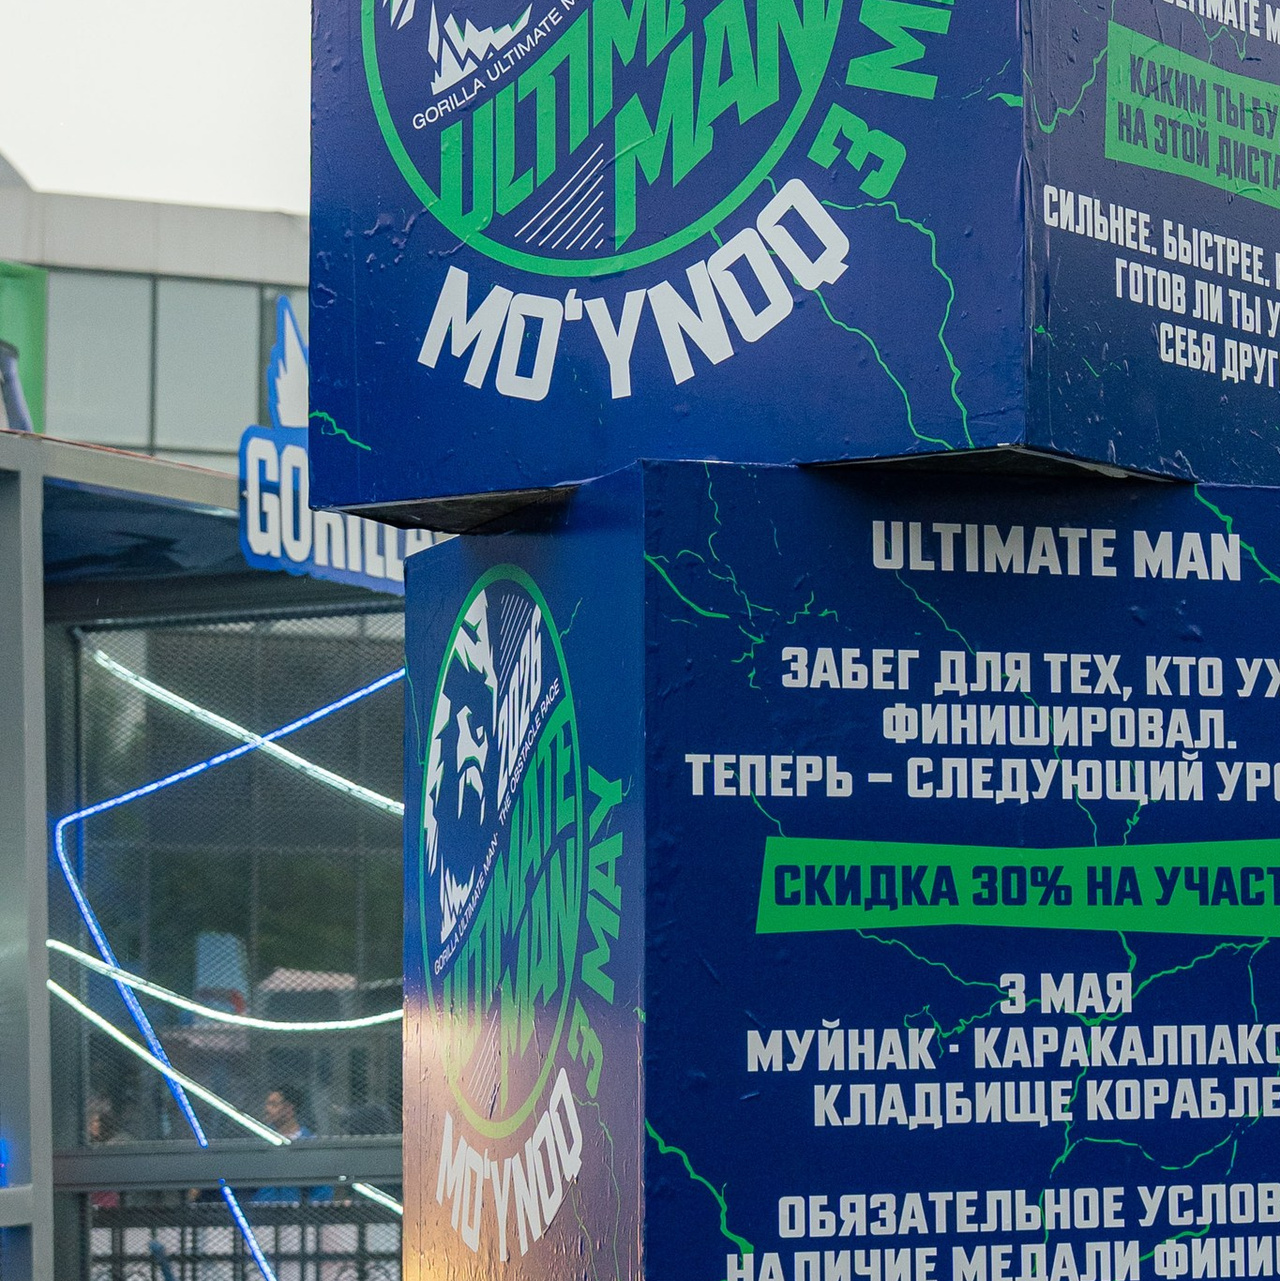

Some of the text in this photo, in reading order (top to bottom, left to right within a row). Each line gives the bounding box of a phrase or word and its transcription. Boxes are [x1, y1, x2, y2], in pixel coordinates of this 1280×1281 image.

[411, 77, 486, 131] GORILLA
[485, 6, 563, 82] ULTIMATE
[1129, 52, 1207, 118] КАКИМ
[1212, 82, 1246, 131] ТЫ
[807, 103, 908, 200] 3
[1117, 101, 1149, 150] НА
[1153, 113, 1210, 169] ЭТОЙ
[1043, 184, 1157, 256] СИЛЬНЕЕ.
[1162, 218, 1271, 288] БЫСТРЕЕ.
[1115, 257, 1186, 315] ГОТОВ
[1192, 279, 1224, 325] ЛИ
[1228, 288, 1262, 335] ТЫ
[1159, 322, 1216, 374] СЕБЯ
[872, 521, 1241, 581] ULTIMATE MAN
[497, 603, 543, 811] 2026
[781, 646, 920, 690] ЗАБЕГ
[934, 650, 1031, 697] ДЛЯ
[1043, 653, 1133, 702] ТЕХ,
[1146, 655, 1223, 697] КТО
[882, 703, 1237, 749] ФИНИШИРОВАЛ.
[685, 753, 853, 797] ТЕПЕРЬ
[907, 751, 1204, 806] СЛЕДУЮЩИЙ
[433, 931, 460, 976] GORILLA
[457, 872, 486, 937] ULTIMATE
[498, 791, 513, 826] THE
[510, 717, 542, 794] OBSTACLE
[540, 677, 561, 720] RACE
[442, 696, 576, 1071] ULTIMATE
[773, 864, 960, 913] СКИДКА
[971, 864, 1073, 907] 30%
[1086, 865, 1144, 907] НА
[566, 765, 623, 1099] 3 MAY
[500, 836, 582, 1118] MAN
[999, 972, 1132, 1014] 3 МАЯ
[747, 1018, 936, 1072] МУЙНАК
[814, 1080, 1073, 1131] КЛАДБИЩЕ
[778, 1186, 1125, 1238] ОБЯЗАТЕЛЬНОЕ
